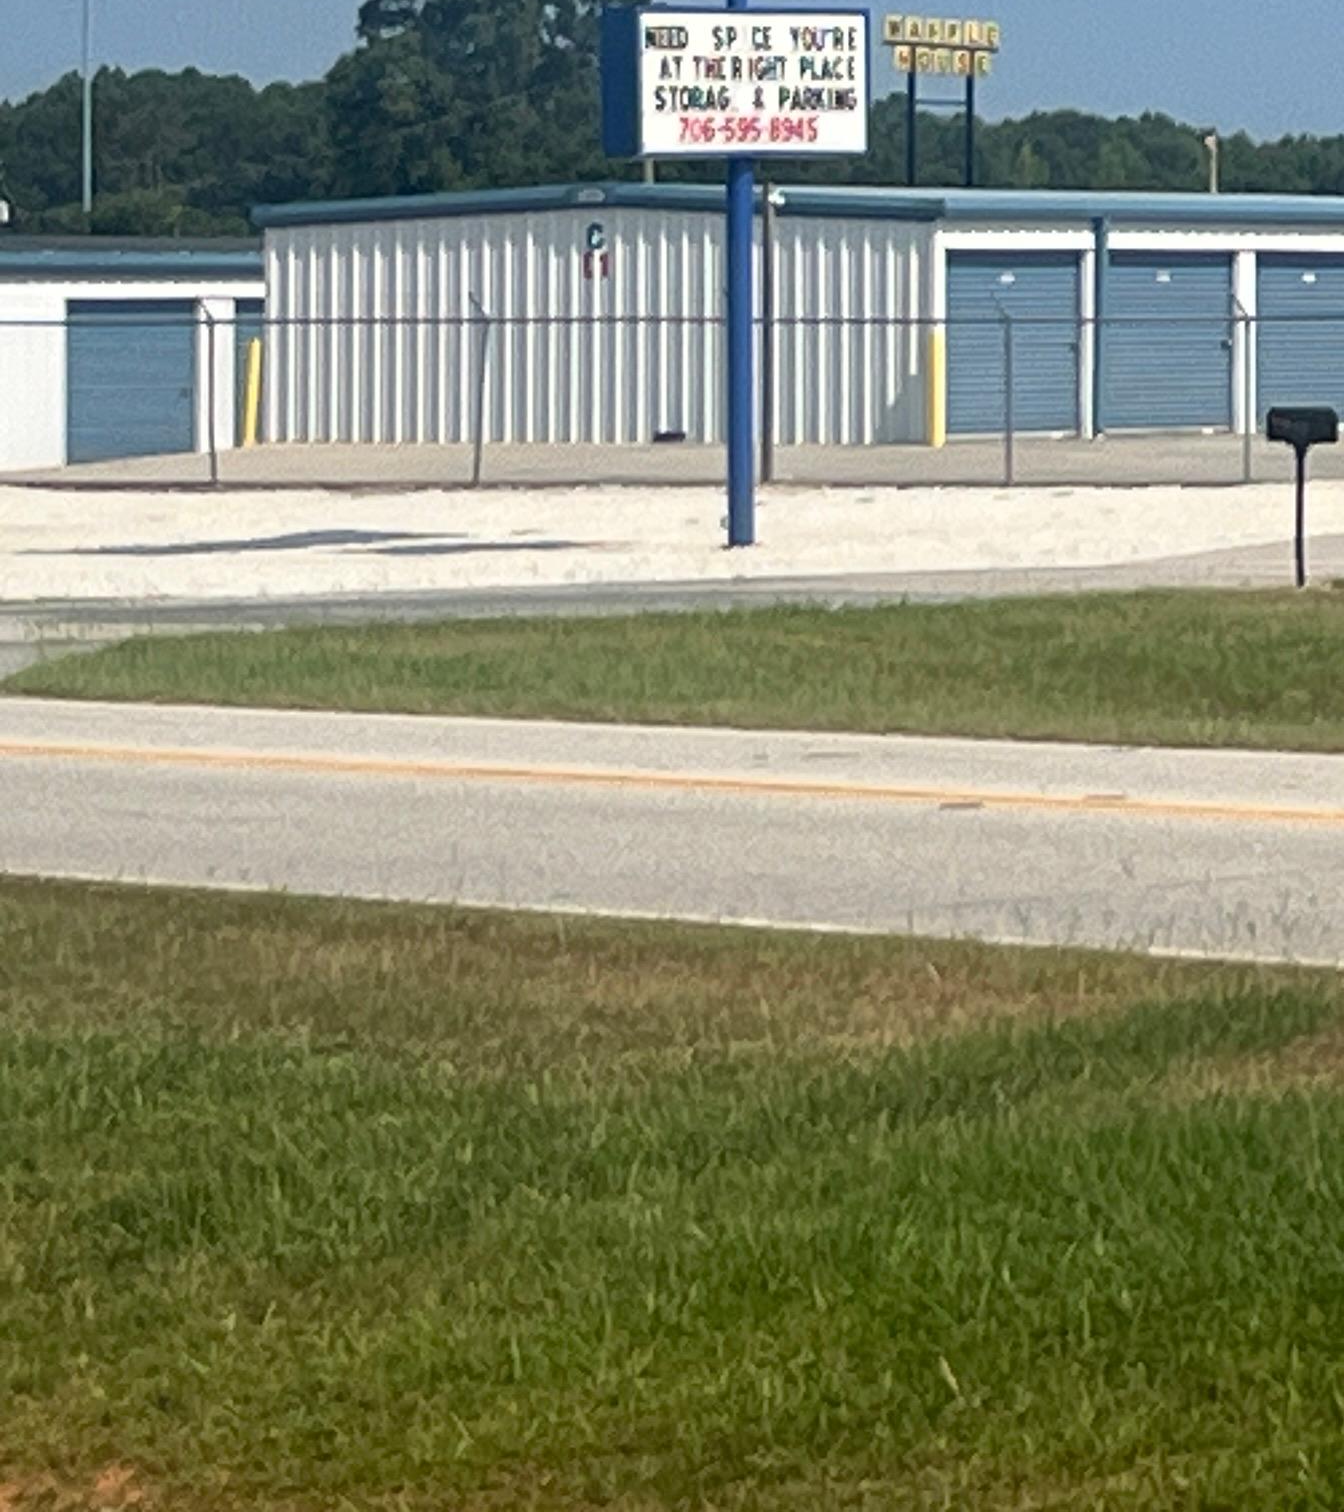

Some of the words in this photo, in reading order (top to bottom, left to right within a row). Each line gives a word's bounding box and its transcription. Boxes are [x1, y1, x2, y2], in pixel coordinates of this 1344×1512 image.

[645, 25, 689, 50] NEED
[789, 25, 857, 52] YOU'RE
[659, 54, 683, 82] AT
[692, 54, 727, 82] THE
[730, 54, 788, 82] RIGHT
[799, 54, 857, 82] PLACE
[654, 85, 738, 113] STORAG
[752, 85, 766, 110] &
[778, 85, 858, 113] PARKING
